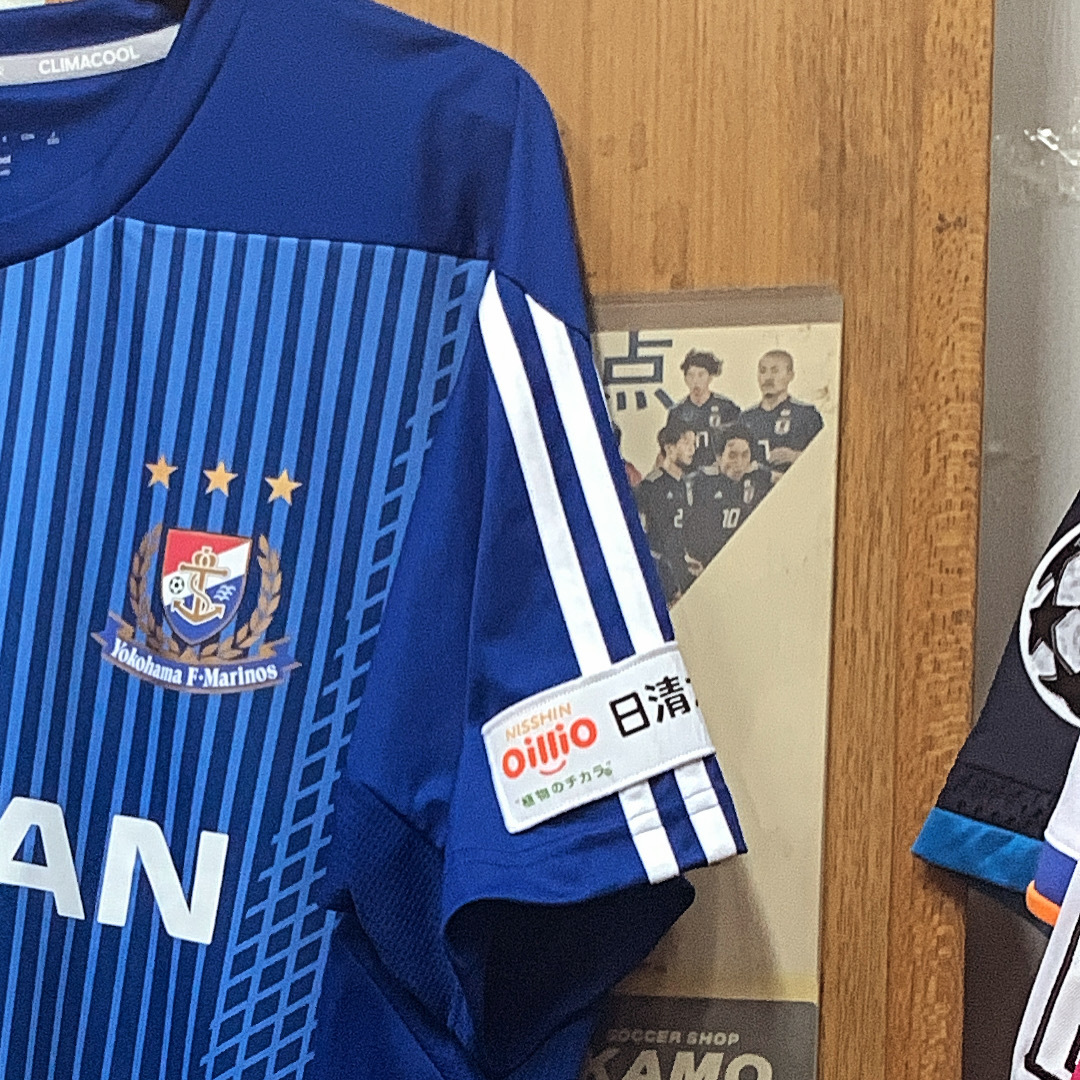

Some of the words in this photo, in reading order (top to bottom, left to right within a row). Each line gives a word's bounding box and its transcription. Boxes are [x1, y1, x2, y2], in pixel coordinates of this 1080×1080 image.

[38, 45, 140, 75] CLIMACOOL
[723, 508, 741, 528] 10
[111, 638, 182, 684] Yokohama
[505, 702, 572, 742] NISSHIN
[609, 676, 699, 737] 日清
[607, 1029, 681, 1044] SOCCER
[687, 1031, 740, 1046] SHOP
